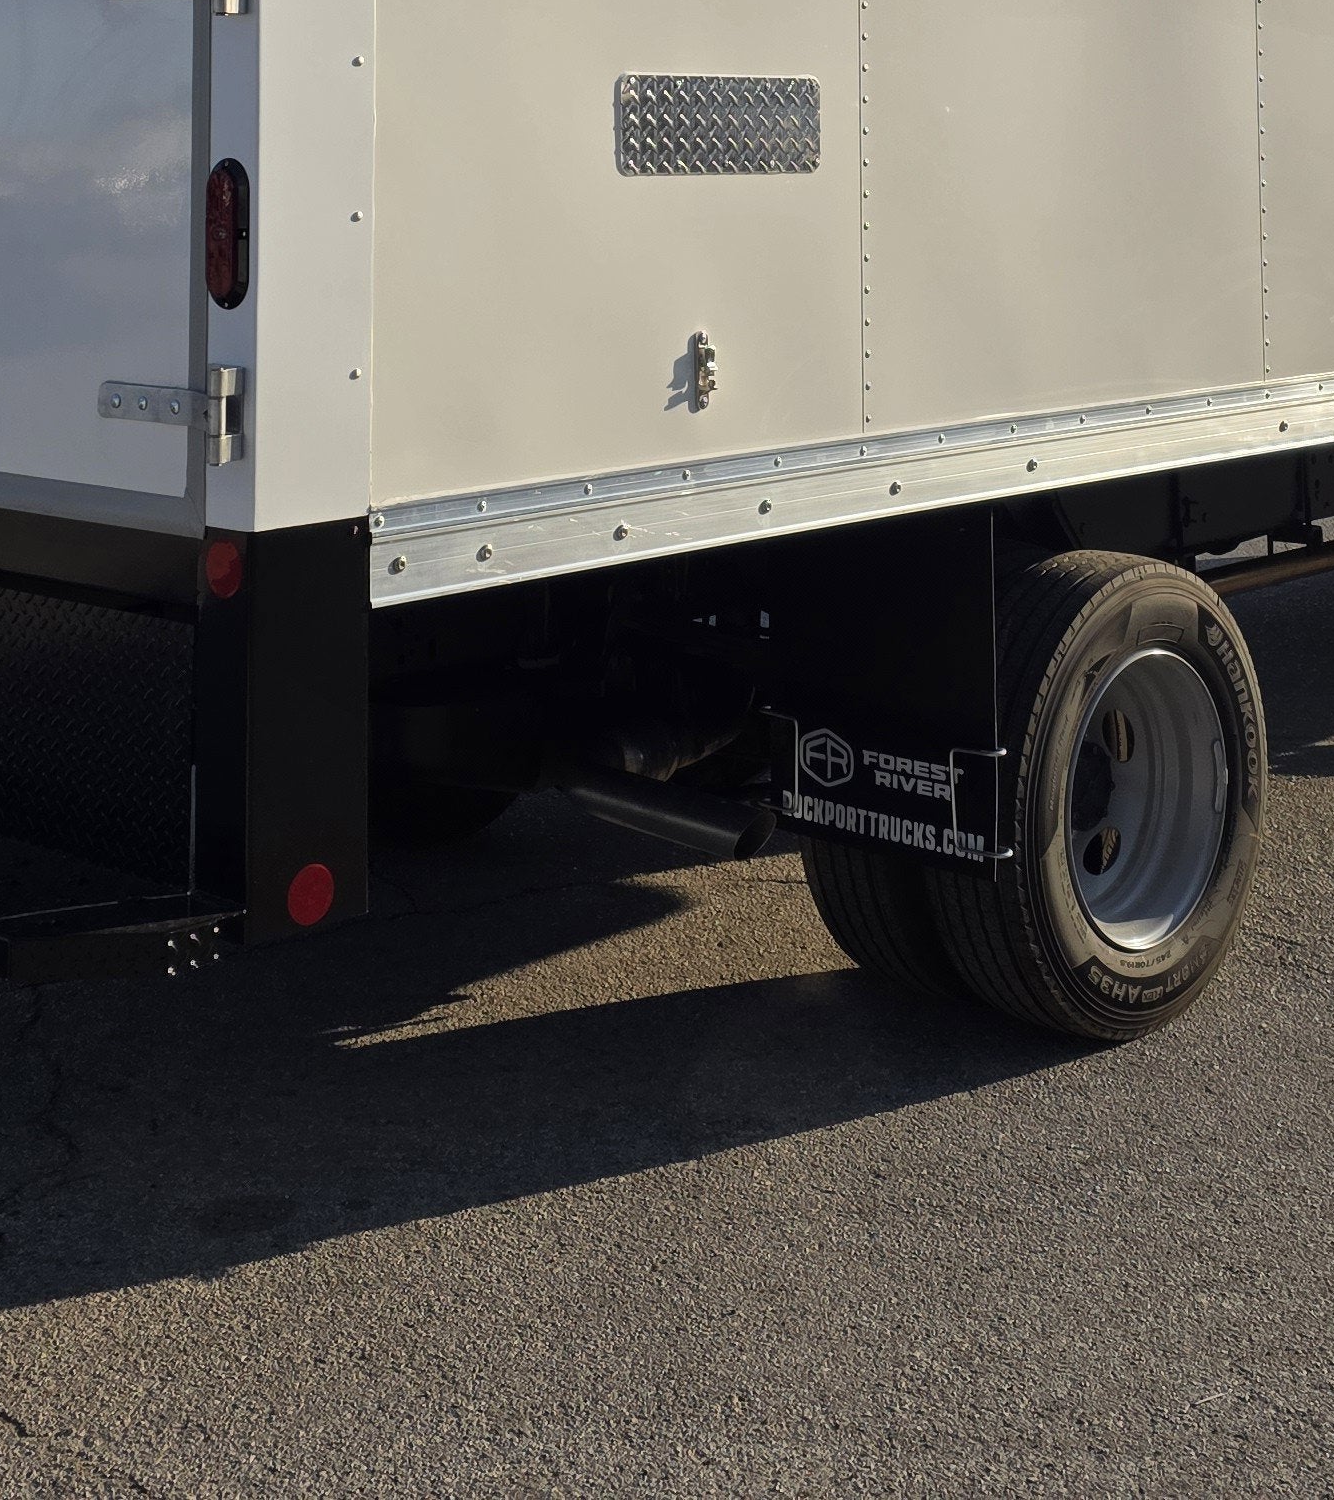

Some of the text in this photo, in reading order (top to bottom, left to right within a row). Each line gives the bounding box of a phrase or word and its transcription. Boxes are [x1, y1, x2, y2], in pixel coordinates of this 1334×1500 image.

[862, 749, 965, 785] FOREST
[873, 769, 952, 802] RIVER
[1087, 965, 1142, 1004] AH35
